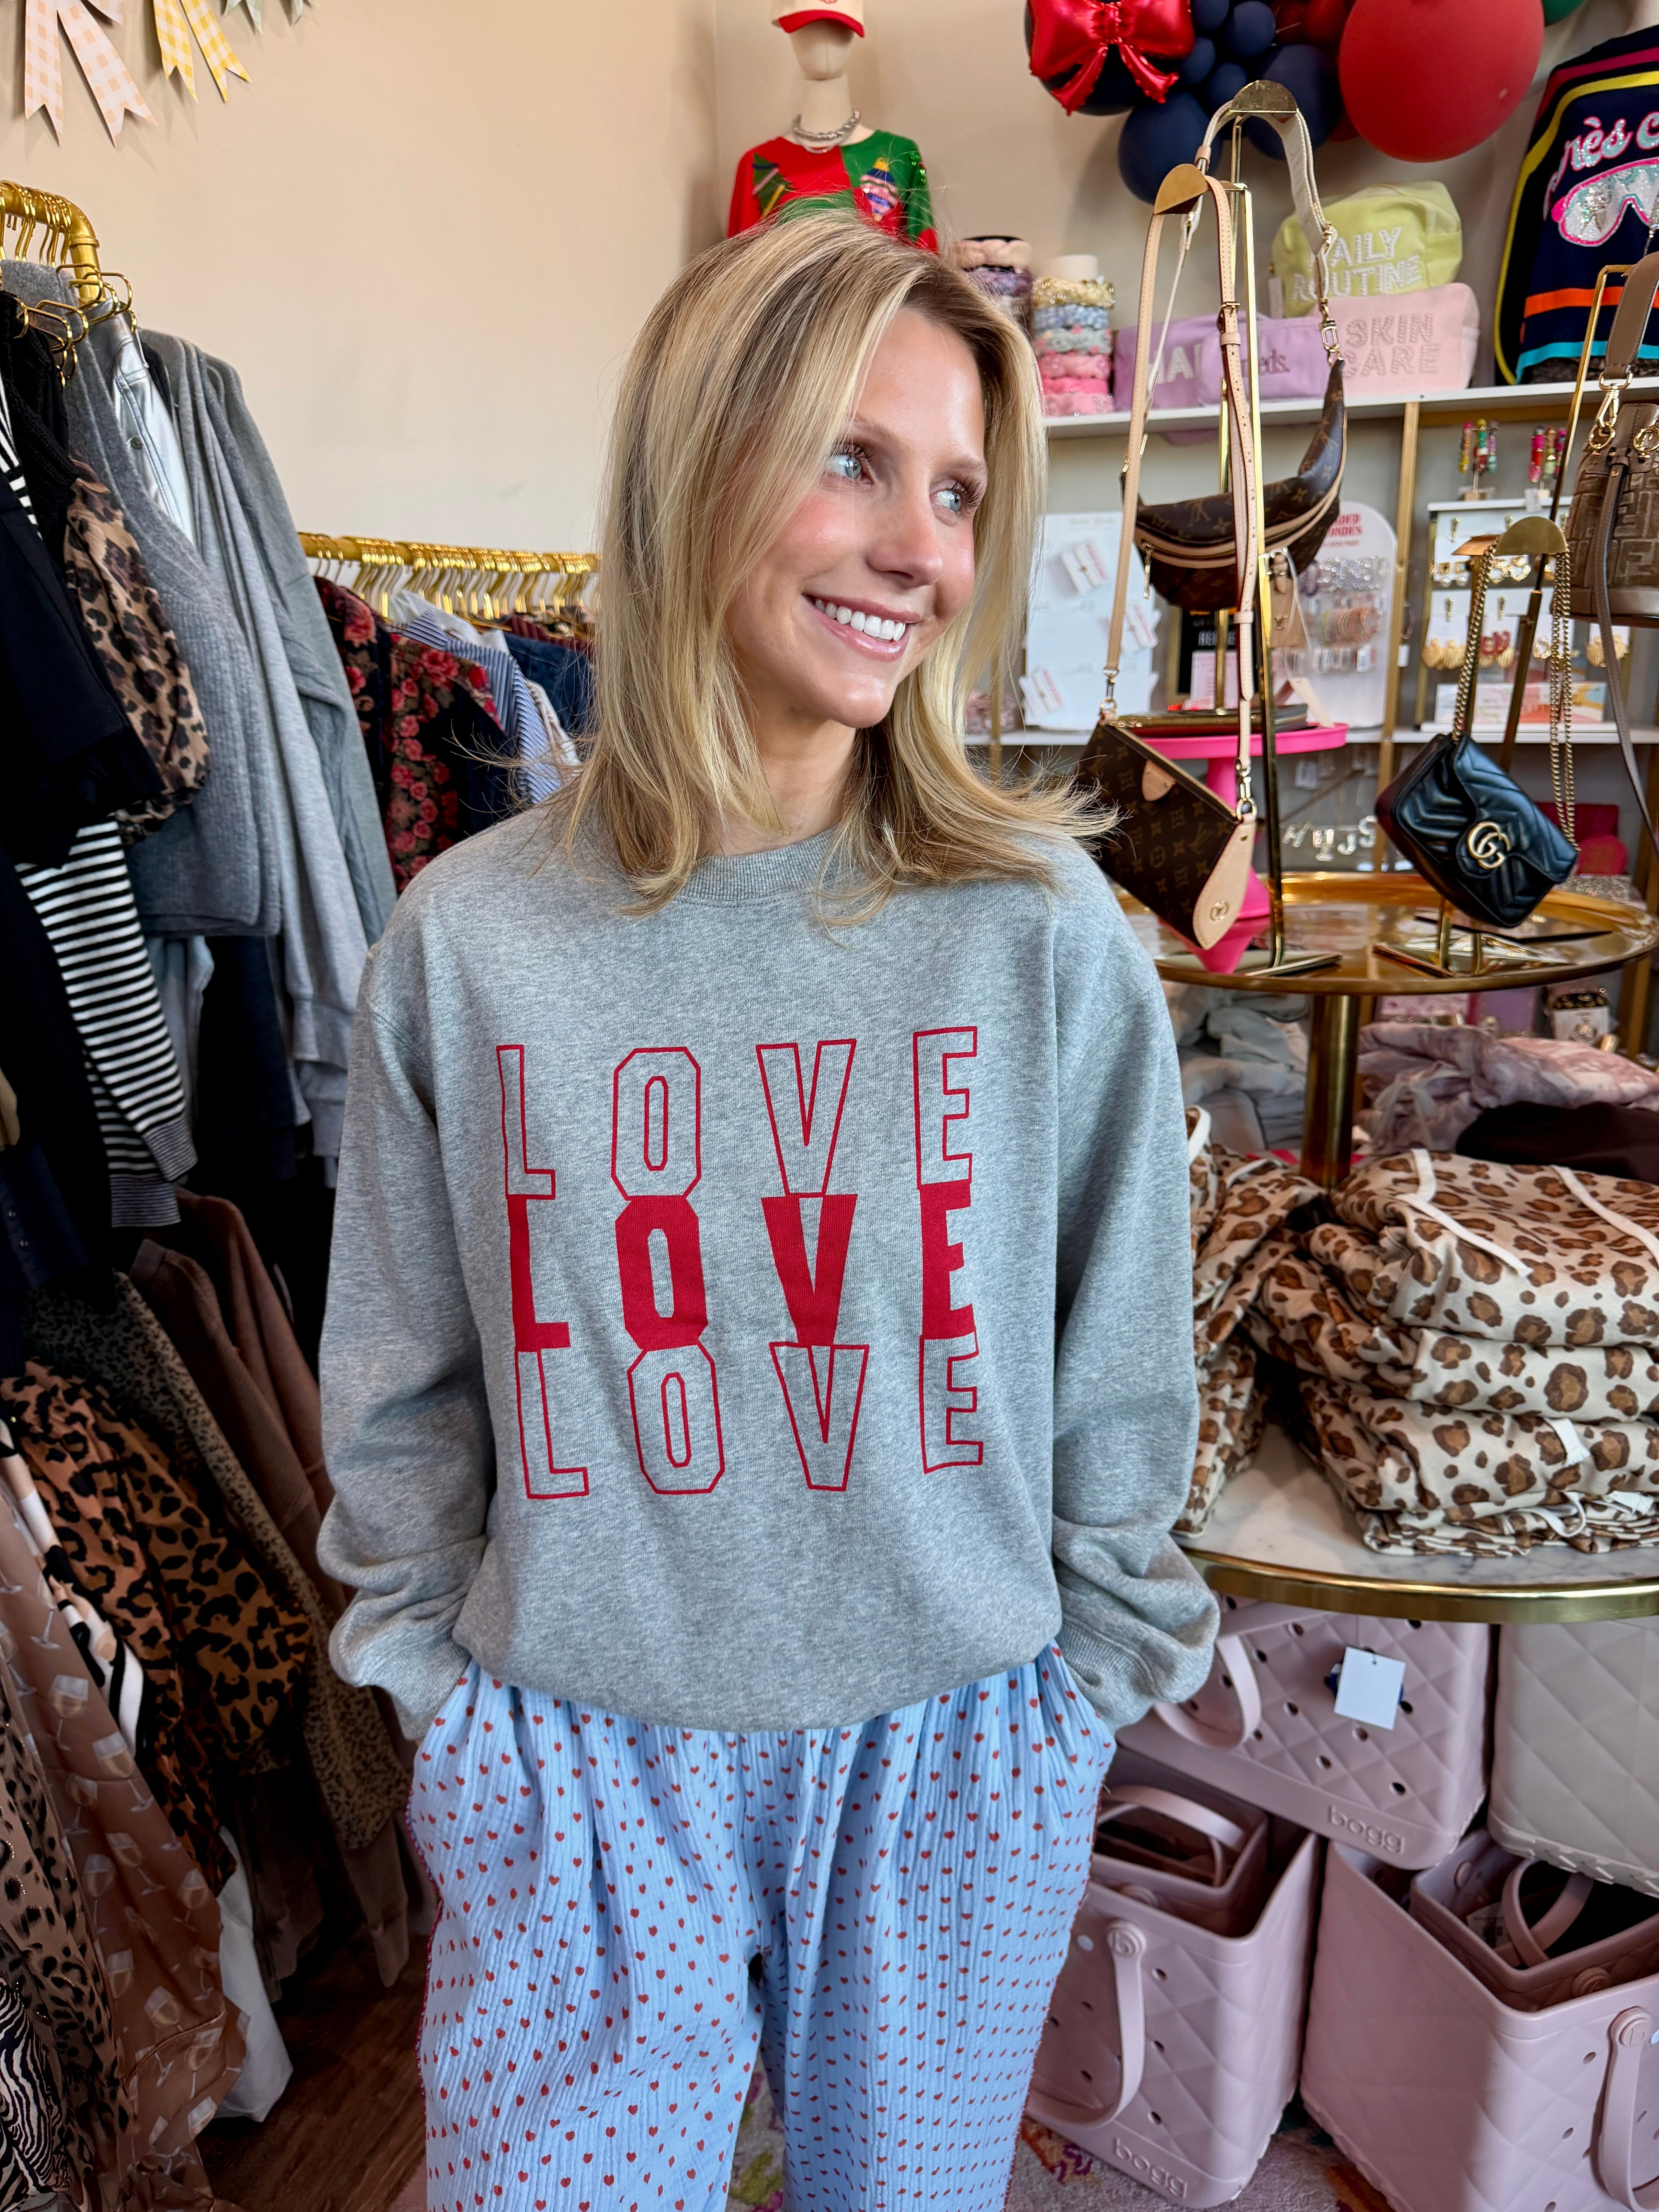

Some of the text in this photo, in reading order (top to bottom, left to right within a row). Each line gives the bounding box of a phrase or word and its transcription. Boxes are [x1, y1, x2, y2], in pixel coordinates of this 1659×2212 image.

[1309, 227, 1401, 270] AILY
[1346, 314, 1433, 346] SKIN
[496, 1026, 977, 1200] LOVE
[507, 1181, 977, 1352] LOVE
[515, 1331, 984, 1499] LOVE
[1328, 1805, 1406, 1855] bogg
[1113, 2137, 1188, 2199] bogg
